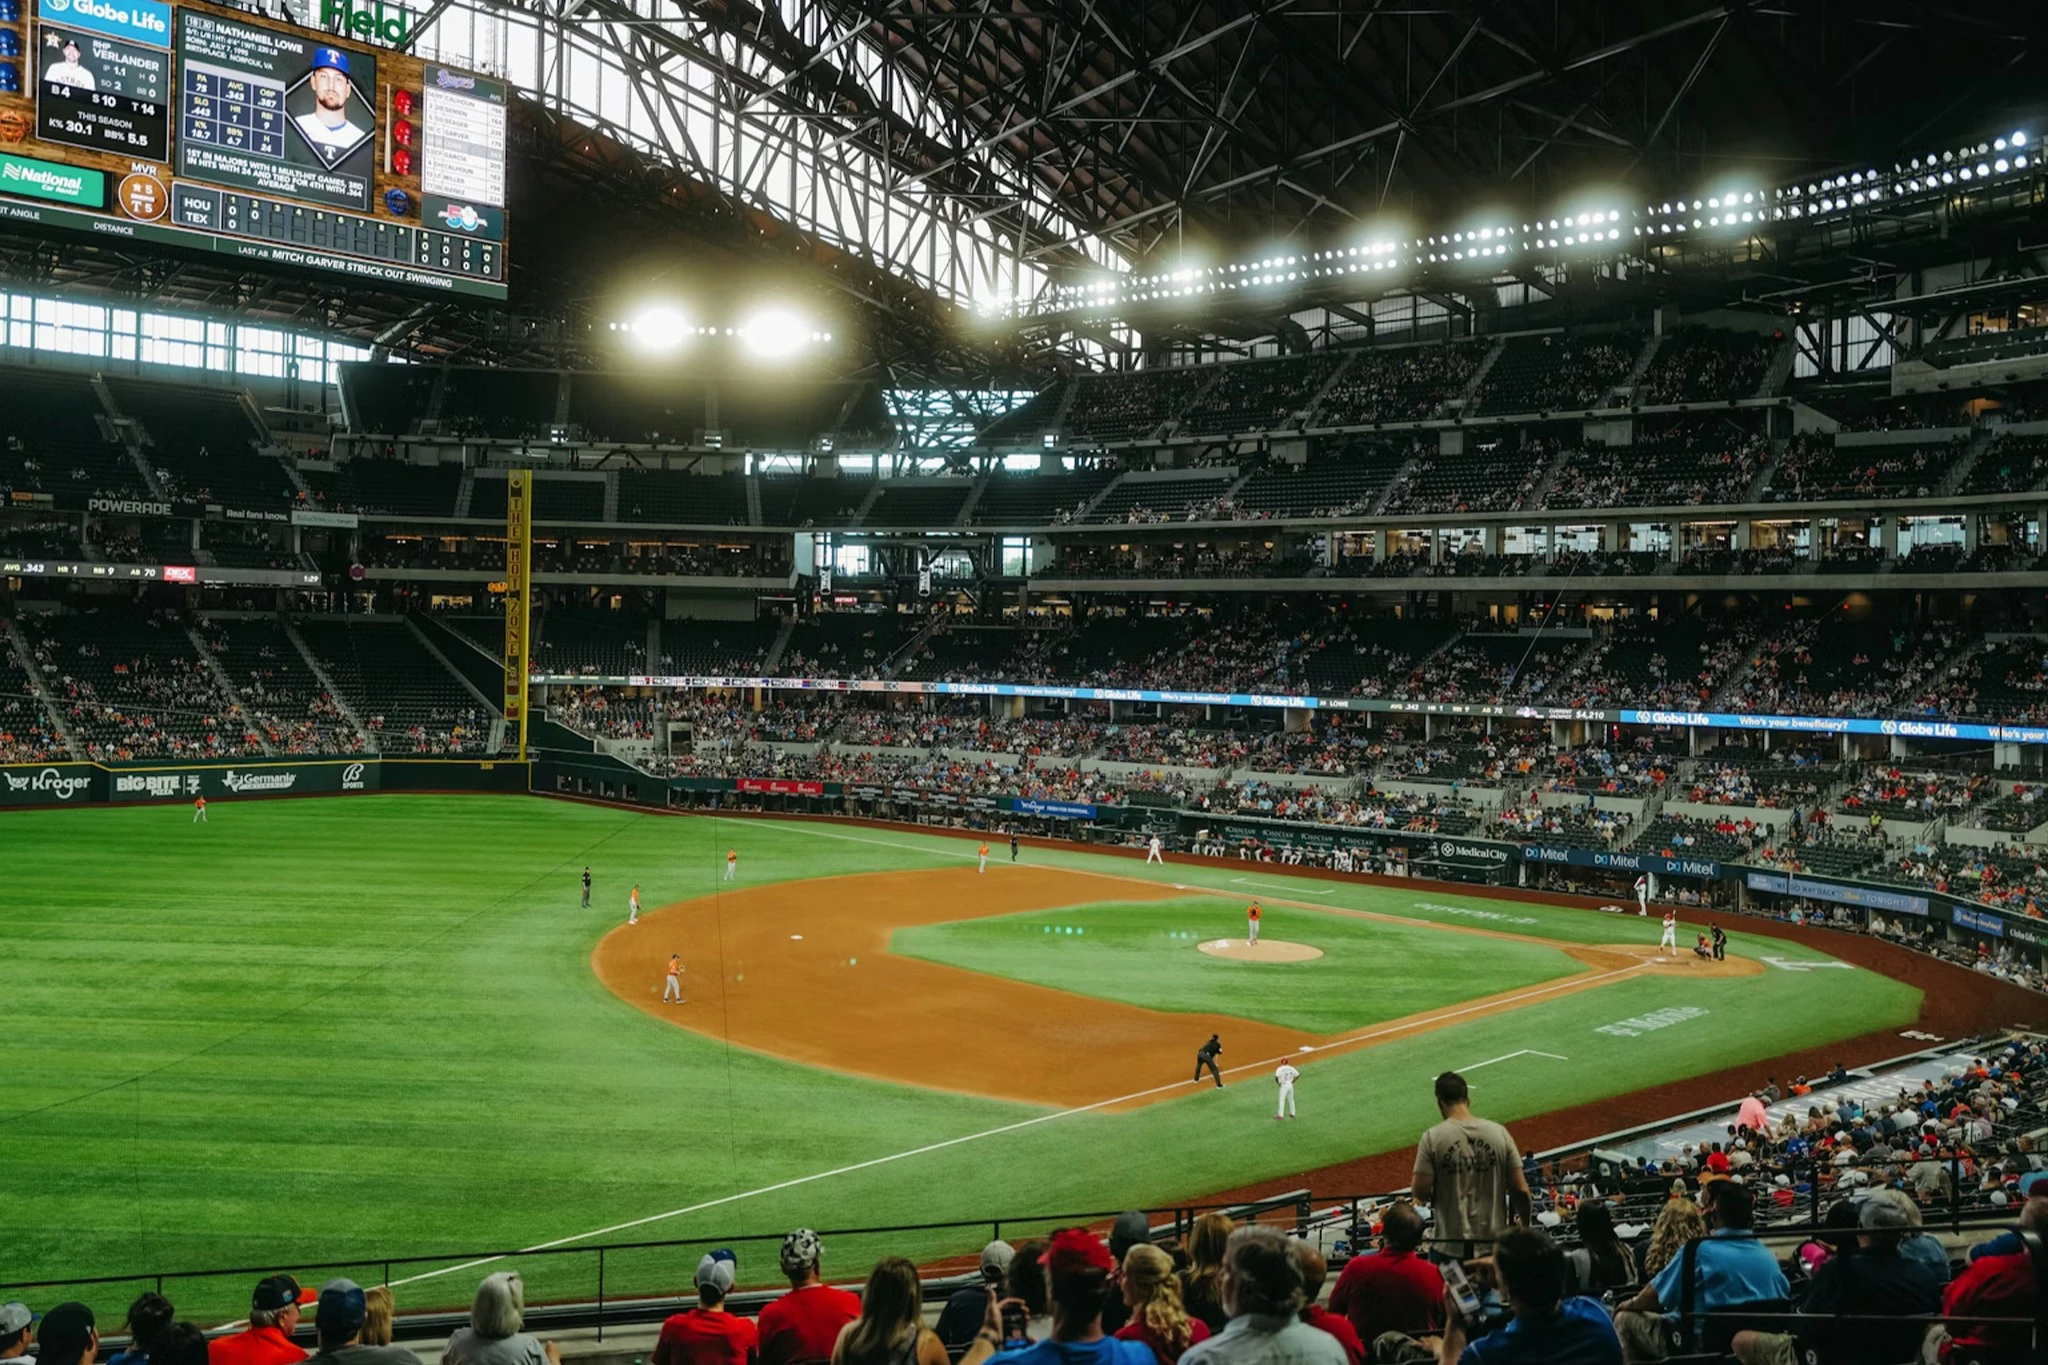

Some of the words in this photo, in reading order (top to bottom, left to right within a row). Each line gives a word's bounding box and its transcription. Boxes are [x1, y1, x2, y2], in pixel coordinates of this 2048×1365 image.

[73, 0, 129, 23] Globe
[132, 10, 165, 32] Life
[93, 40, 111, 49] RHP
[216, 24, 274, 46] NATHANIEL
[275, 40, 304, 53] LOWE
[185, 43, 227, 60] BIRTHPLACE:
[229, 54, 262, 68] NORFOLK,
[264, 62, 273, 70] VA
[209, 41, 225, 51] JULY
[233, 47, 249, 56] 1995
[93, 48, 160, 72] VERLANDER
[113, 66, 126, 77] 1.1
[148, 74, 156, 84] 0
[114, 81, 121, 91] 2
[148, 88, 156, 98] 0
[196, 84, 207, 93] 75
[225, 91, 244, 101] .343
[197, 74, 207, 82] PA
[228, 81, 244, 91] AVG
[260, 88, 275, 97] OBP
[52, 85, 59, 95] B
[61, 86, 71, 98] 4
[92, 93, 99, 103] S
[101, 94, 116, 107] 10
[132, 102, 139, 112] T
[141, 103, 155, 115] 14
[194, 97, 208, 106] SLG
[230, 105, 241, 113] HR
[77, 111, 97, 123] THIS
[98, 115, 132, 129] SEASON
[191, 106, 211, 117] .443
[232, 115, 237, 123] 1
[49, 117, 63, 129] K%
[65, 120, 93, 135] 30.1
[104, 129, 125, 141] BB%
[128, 132, 148, 146] 5.5
[191, 129, 211, 139] 18.7
[227, 137, 241, 146] 6.7
[261, 144, 272, 152] 24
[131, 163, 157, 176] MVR
[187, 148, 201, 158] 1ST
[203, 150, 213, 160] IN
[214, 153, 248, 167] MAJORS
[250, 159, 270, 171] WITH
[278, 164, 317, 180] MULTI-HIT
[318, 172, 346, 187] GAMES,
[187, 157, 197, 166] IN
[199, 159, 217, 169] HITS
[219, 162, 240, 174] WITH
[241, 167, 251, 176] 24
[253, 169, 271, 180] AND
[273, 172, 291, 184] TIED
[292, 176, 308, 187] FOR
[309, 180, 325, 190] 4TH
[327, 183, 346, 194] WITH
[42, 184, 53, 193] Car
[56, 187, 79, 196] Rental
[257, 178, 297, 192] AVERAGE.
[131, 200, 142, 213] T
[145, 203, 153, 213] 5
[231, 196, 236, 204] 1
[10, 208, 40, 220] ANGLE
[93, 222, 134, 236] DISTANCE
[184, 197, 211, 211] HOU
[228, 206, 237, 216] 0
[251, 210, 259, 220] 0
[421, 242, 429, 251] 0
[442, 245, 450, 254] 0
[463, 249, 470, 258] 0
[483, 253, 491, 262] 0
[186, 211, 208, 225] TEX
[228, 220, 237, 230] 0
[421, 254, 429, 263] 0
[442, 258, 450, 267] 0
[463, 261, 470, 270] 0
[483, 265, 490, 274] 0
[238, 246, 257, 257] LAST
[258, 250, 269, 258] AB
[272, 249, 304, 264] MITCH
[306, 254, 345, 270] GARVER
[347, 261, 383, 276] STRUCK
[385, 268, 405, 280] OUT
[406, 272, 453, 288] SWINGING
[88, 499, 172, 515] POWERADE
[227, 509, 245, 518] Real
[247, 511, 263, 520] fans
[264, 512, 289, 521] know.
[511, 499, 521, 539] THE
[23, 564, 44, 573] .343
[72, 566, 78, 574] 1
[108, 567, 114, 575] 9
[130, 568, 140, 576] AB
[144, 568, 155, 577] 70
[304, 575, 319, 583] 1:29
[509, 550, 520, 591] HOT
[960, 684, 982, 693] Globe
[984, 685, 998, 693] Life
[1104, 691, 1126, 699] Globe
[1127, 691, 1142, 700] Life
[1263, 696, 1287, 706] Globe
[1289, 697, 1306, 707] Life
[1330, 700, 1349, 708] LOWE
[1576, 711, 1604, 719] $4,210
[1652, 711, 1685, 724] Globe
[1688, 712, 1709, 725] Life
[1740, 717, 1767, 726] Who's
[1768, 719, 1789, 729] your
[1791, 717, 1848, 730] beneficiary?
[1899, 722, 1933, 735] Globe
[1935, 724, 1957, 736] Life
[2022, 731, 2044, 741] your
[32, 768, 91, 799] Kroger
[146, 775, 180, 790] BITE
[244, 772, 295, 784] Germania
[151, 788, 174, 796] PIZZA
[1456, 846, 1489, 858] Medical
[1490, 848, 1508, 861] City
[1540, 848, 1569, 862] Mitel
[1610, 854, 1640, 868] Mitel
[1682, 861, 1715, 875] Mitel
